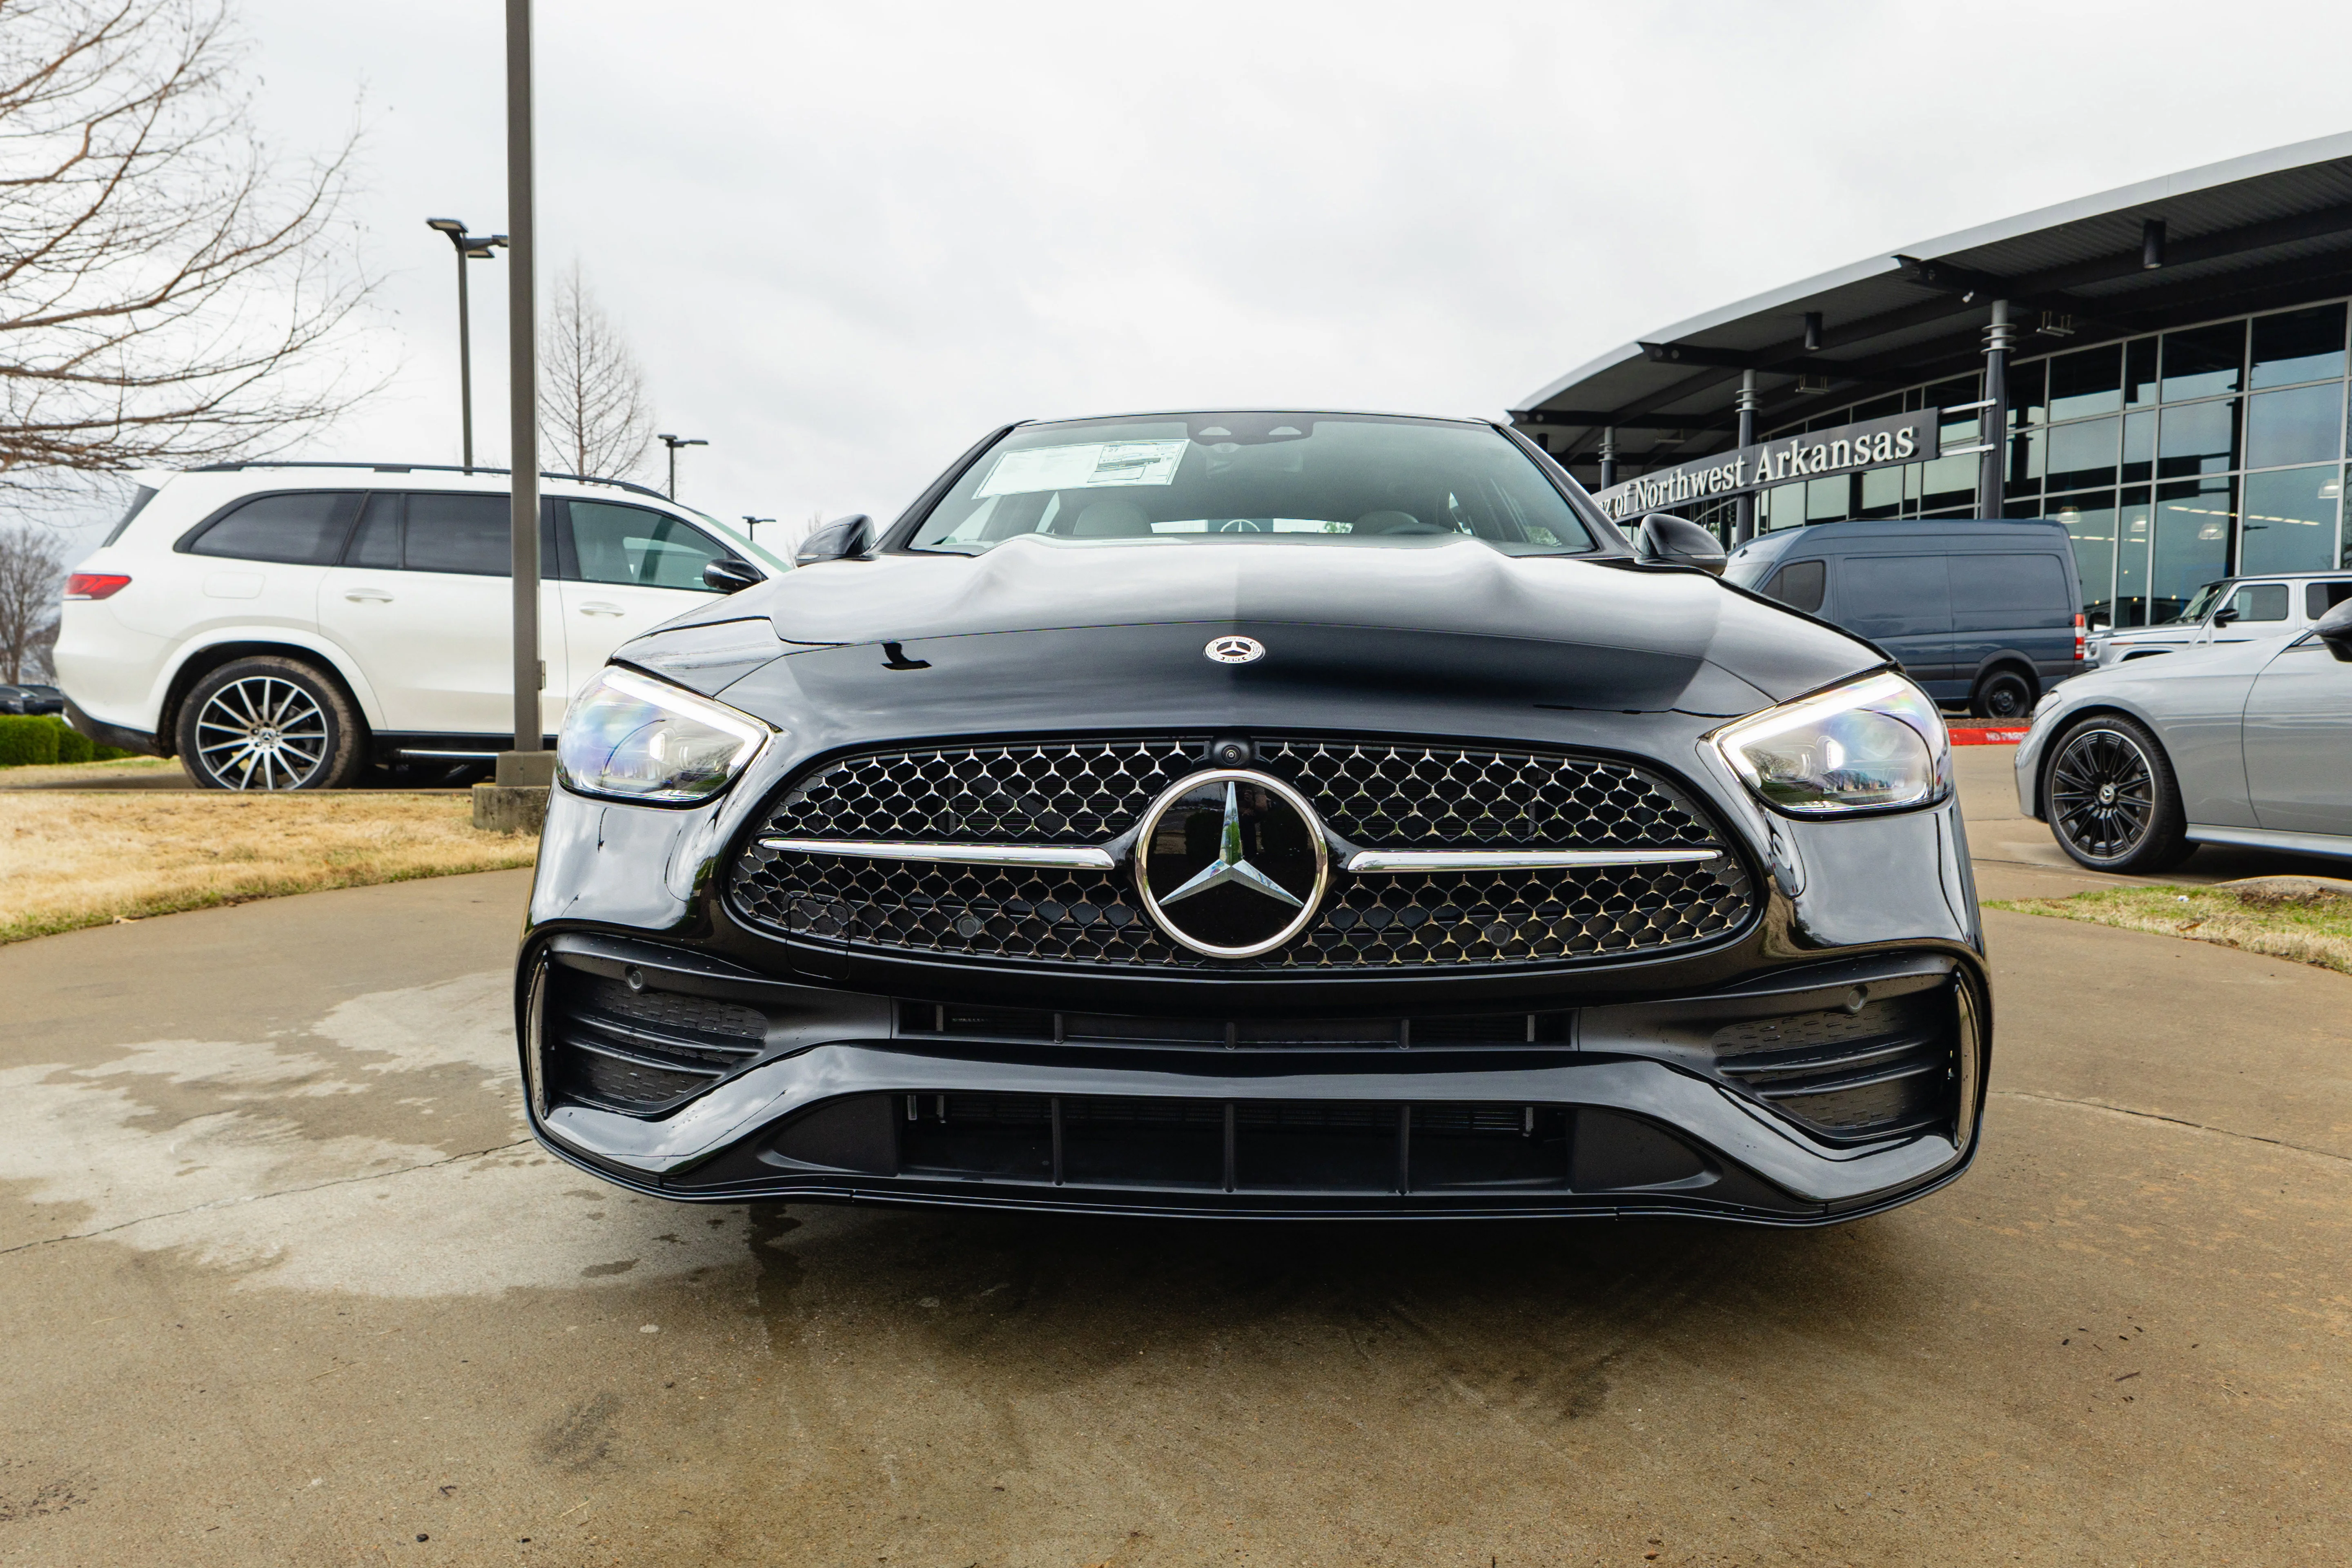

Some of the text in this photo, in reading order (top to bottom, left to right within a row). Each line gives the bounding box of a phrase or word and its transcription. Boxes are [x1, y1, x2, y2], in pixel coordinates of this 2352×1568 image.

[1615, 483, 1631, 517] of
[1634, 455, 1745, 512] Northwest
[1752, 426, 1914, 485] Arkansas
[1985, 732, 2000, 742] NO
